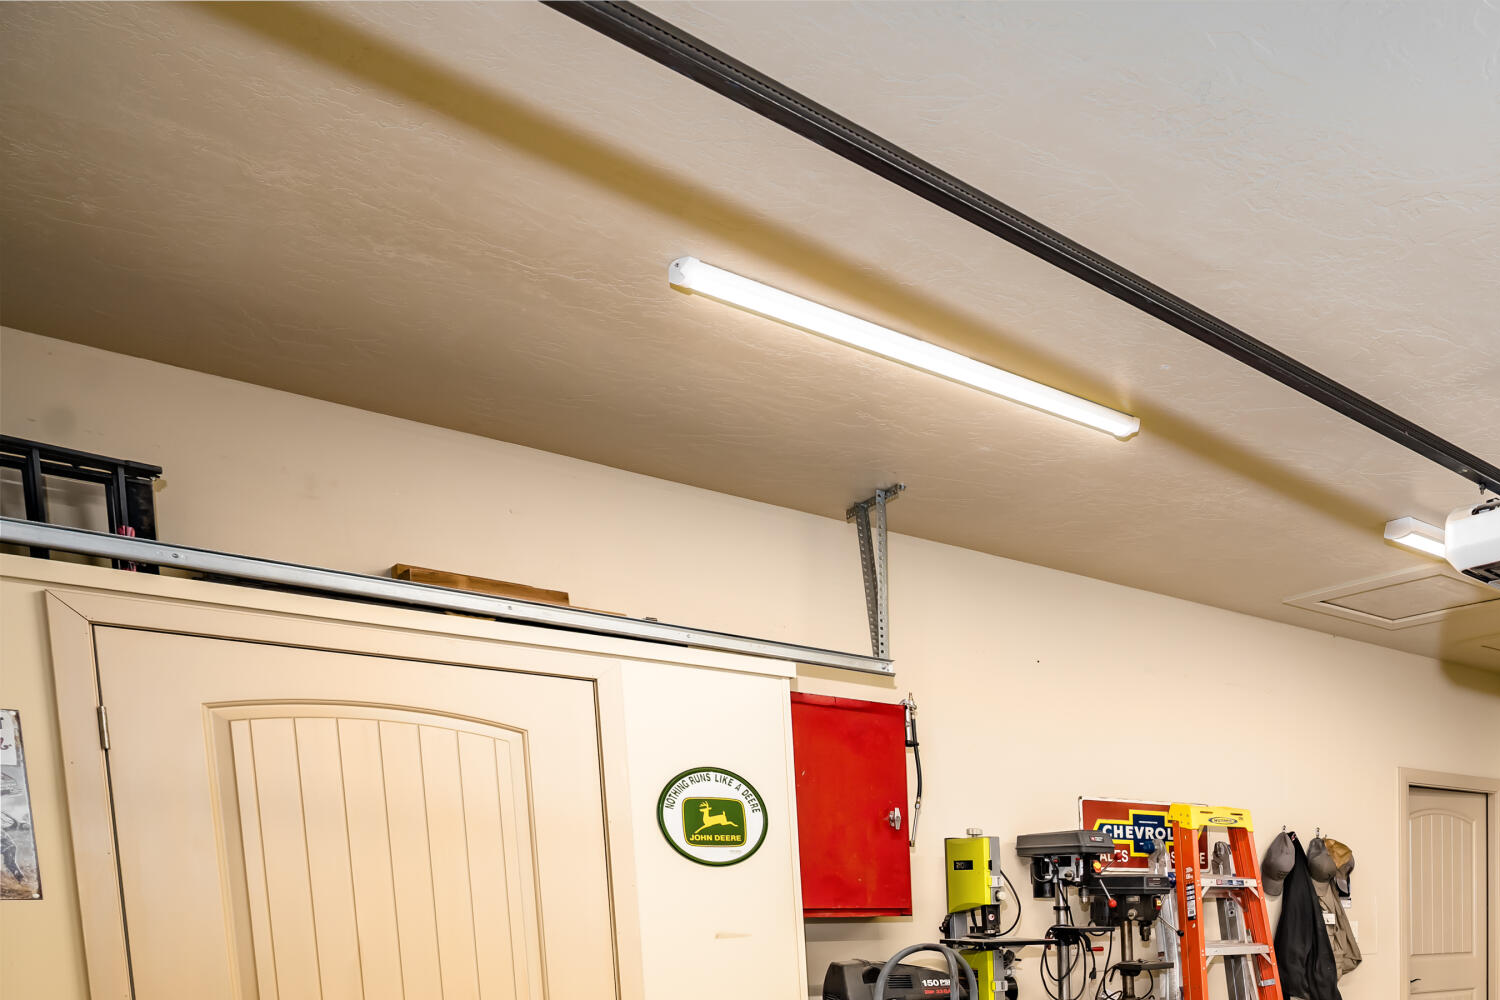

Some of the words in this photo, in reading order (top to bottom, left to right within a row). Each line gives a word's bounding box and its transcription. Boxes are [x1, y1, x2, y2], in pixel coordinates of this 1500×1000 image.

[665, 779, 689, 810] NOTHING
[688, 772, 712, 786] RUNS
[714, 773, 734, 787] LIKE
[734, 783, 742, 792] A
[741, 789, 761, 814] DEERE
[689, 833, 713, 842] JOHN
[714, 833, 742, 842] DEERE
[1102, 824, 1174, 841] CHEVROL
[921, 979, 940, 987] 150
